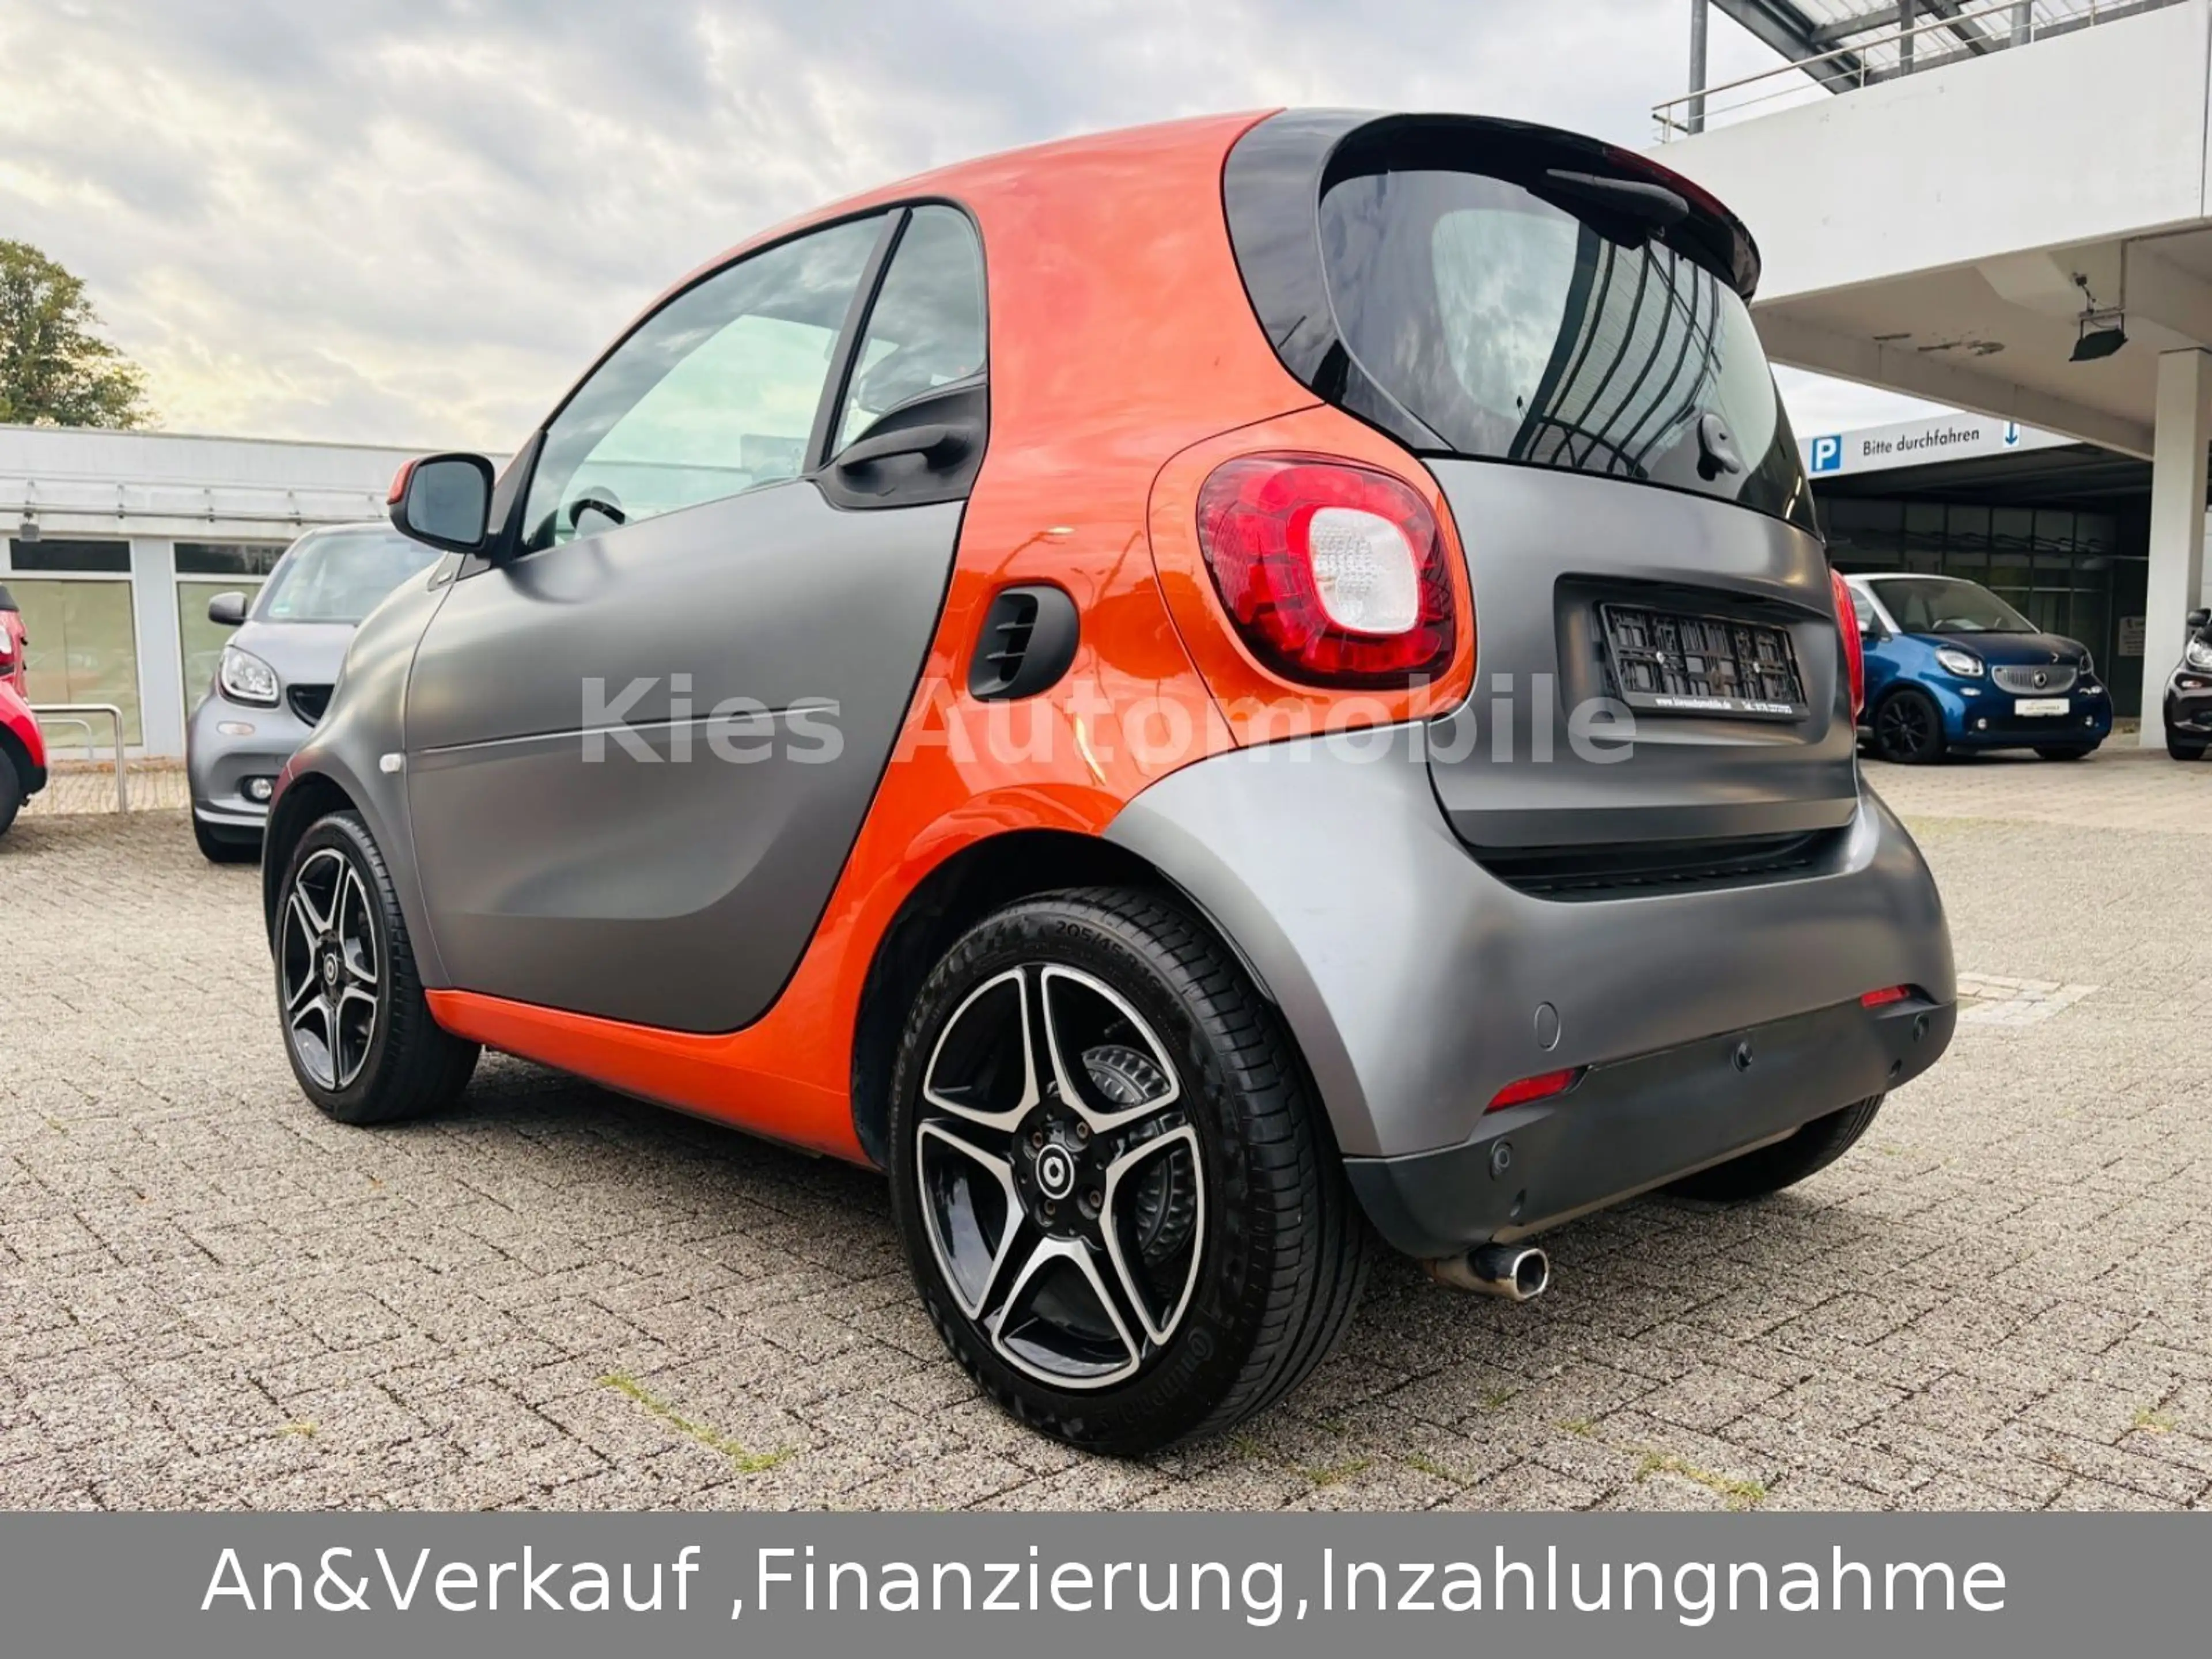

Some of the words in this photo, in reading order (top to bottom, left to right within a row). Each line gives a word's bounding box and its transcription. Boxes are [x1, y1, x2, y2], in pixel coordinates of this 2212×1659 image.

[1816, 438, 1836, 471] P
[1862, 440, 1892, 457] Bitte
[1896, 427, 1980, 452] durchfahren
